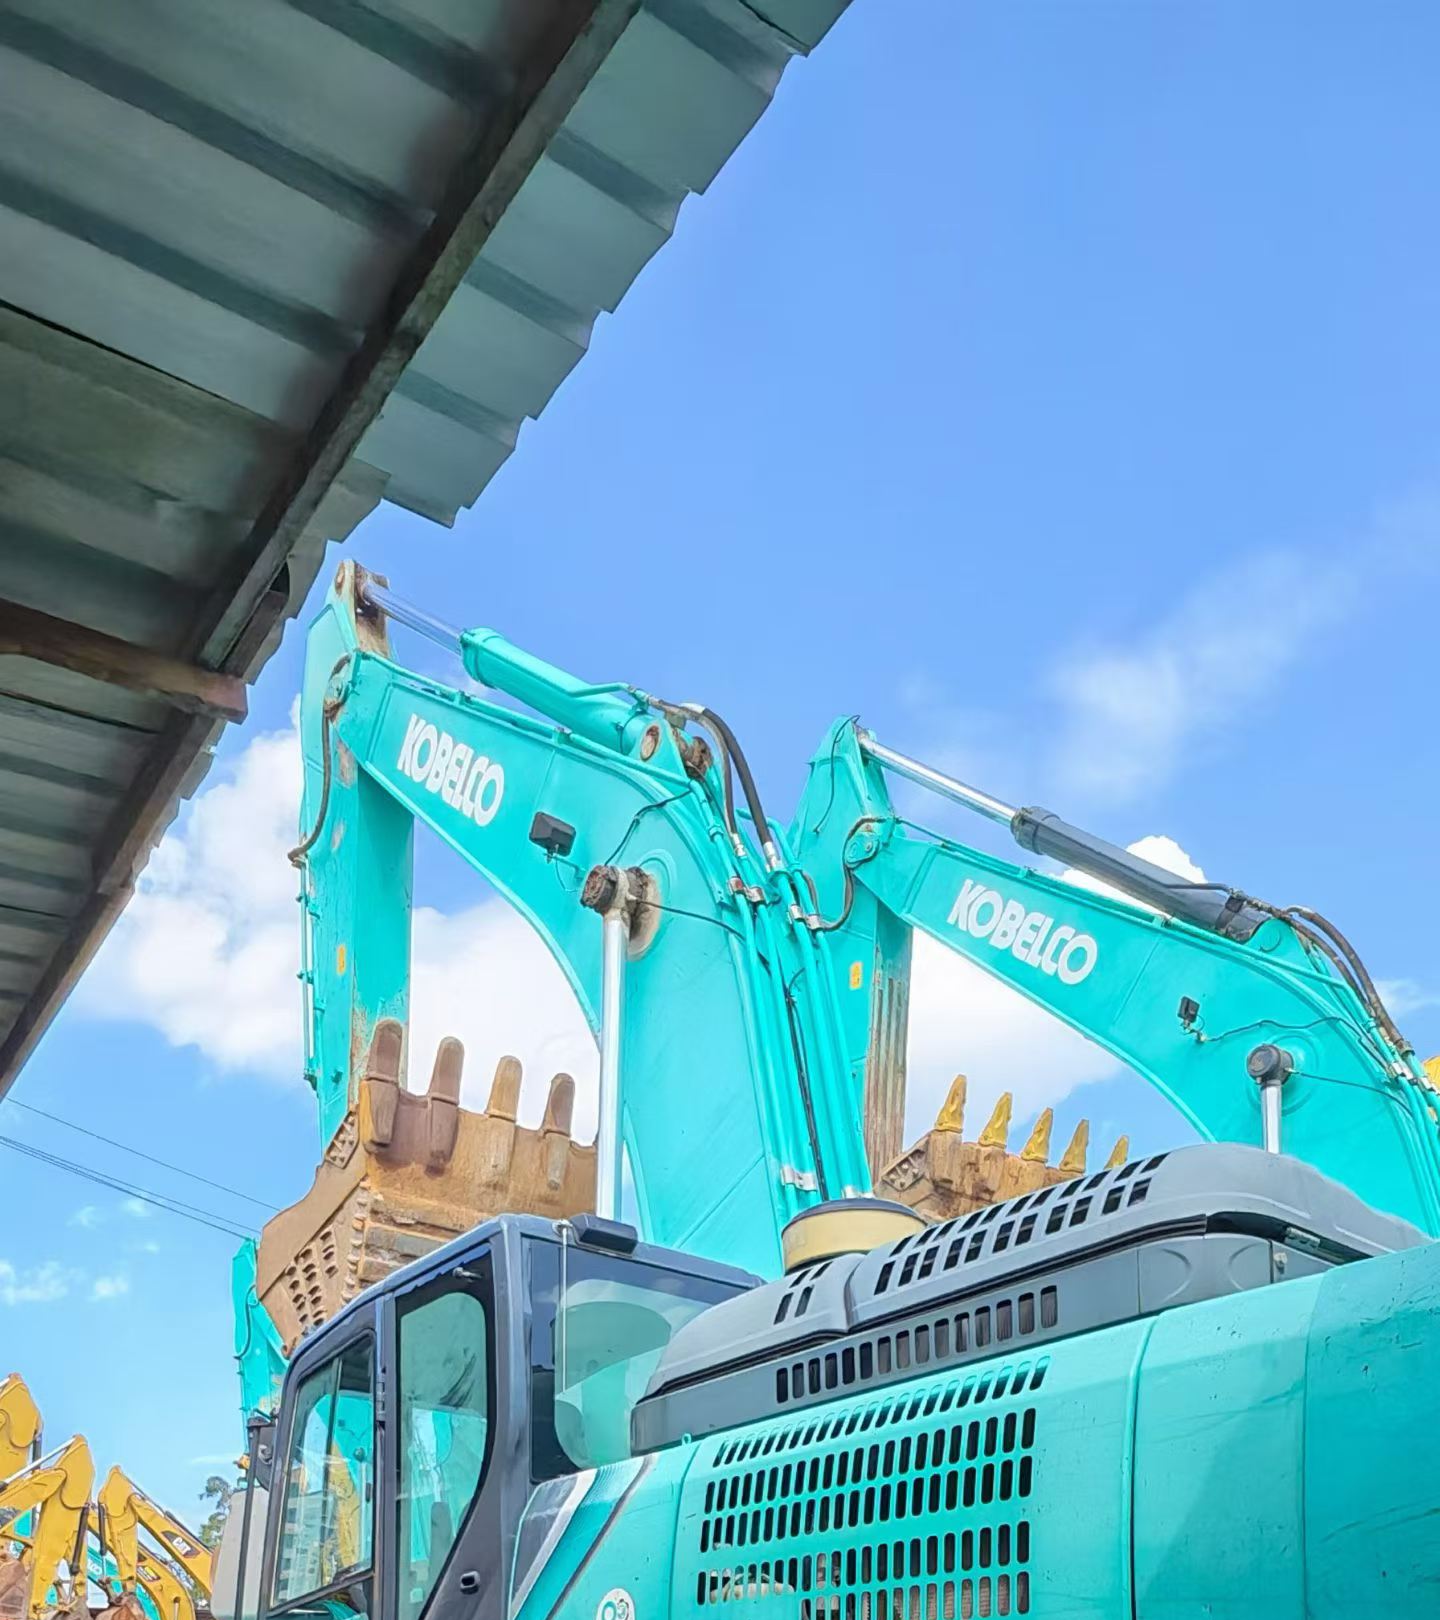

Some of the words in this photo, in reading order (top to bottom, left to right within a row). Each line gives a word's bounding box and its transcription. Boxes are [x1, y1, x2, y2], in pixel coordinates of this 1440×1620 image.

[396, 712, 505, 827] KOBELCO
[946, 878, 1098, 985] KOBELCO
[172, 1536, 191, 1555] CAT
